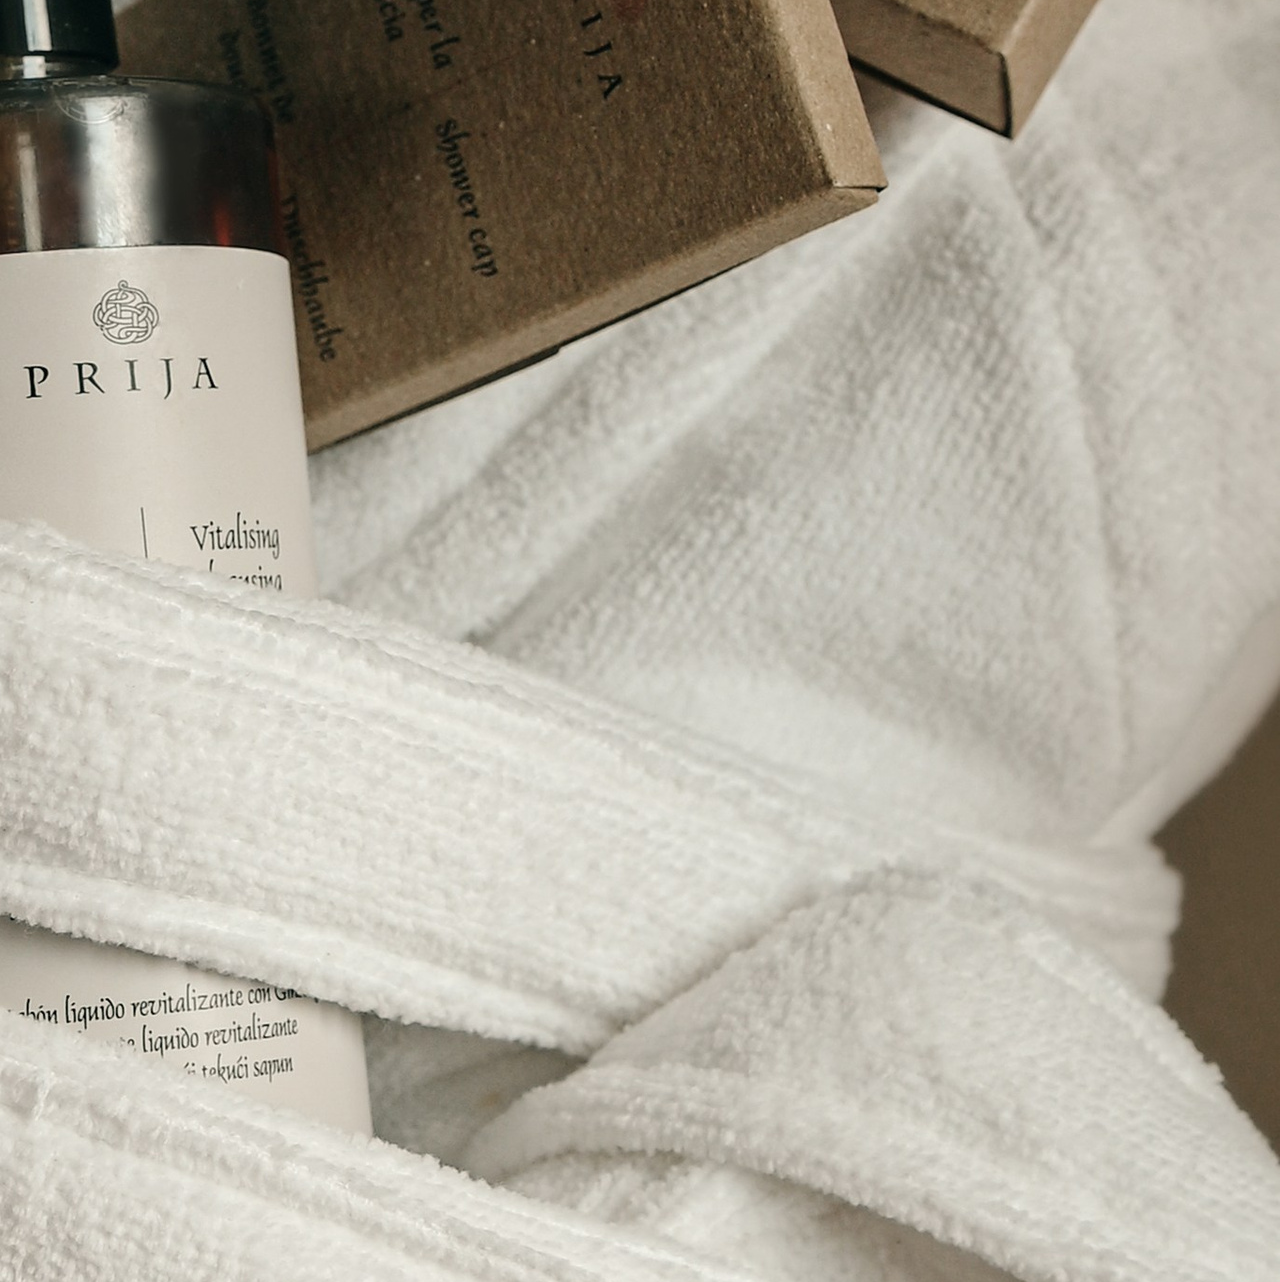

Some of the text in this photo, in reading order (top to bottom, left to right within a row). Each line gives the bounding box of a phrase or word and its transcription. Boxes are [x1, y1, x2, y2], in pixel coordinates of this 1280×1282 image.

[430, 35, 461, 70] la
[469, 228, 499, 278] cap
[23, 357, 219, 400] PRIJA
[189, 511, 281, 560] Vitalising
[65, 994, 125, 1030] líquido
[131, 983, 244, 1017] revitalizante
[248, 987, 272, 1005] con
[204, 1012, 299, 1046] revitalizante
[253, 1057, 294, 1083] sapun
